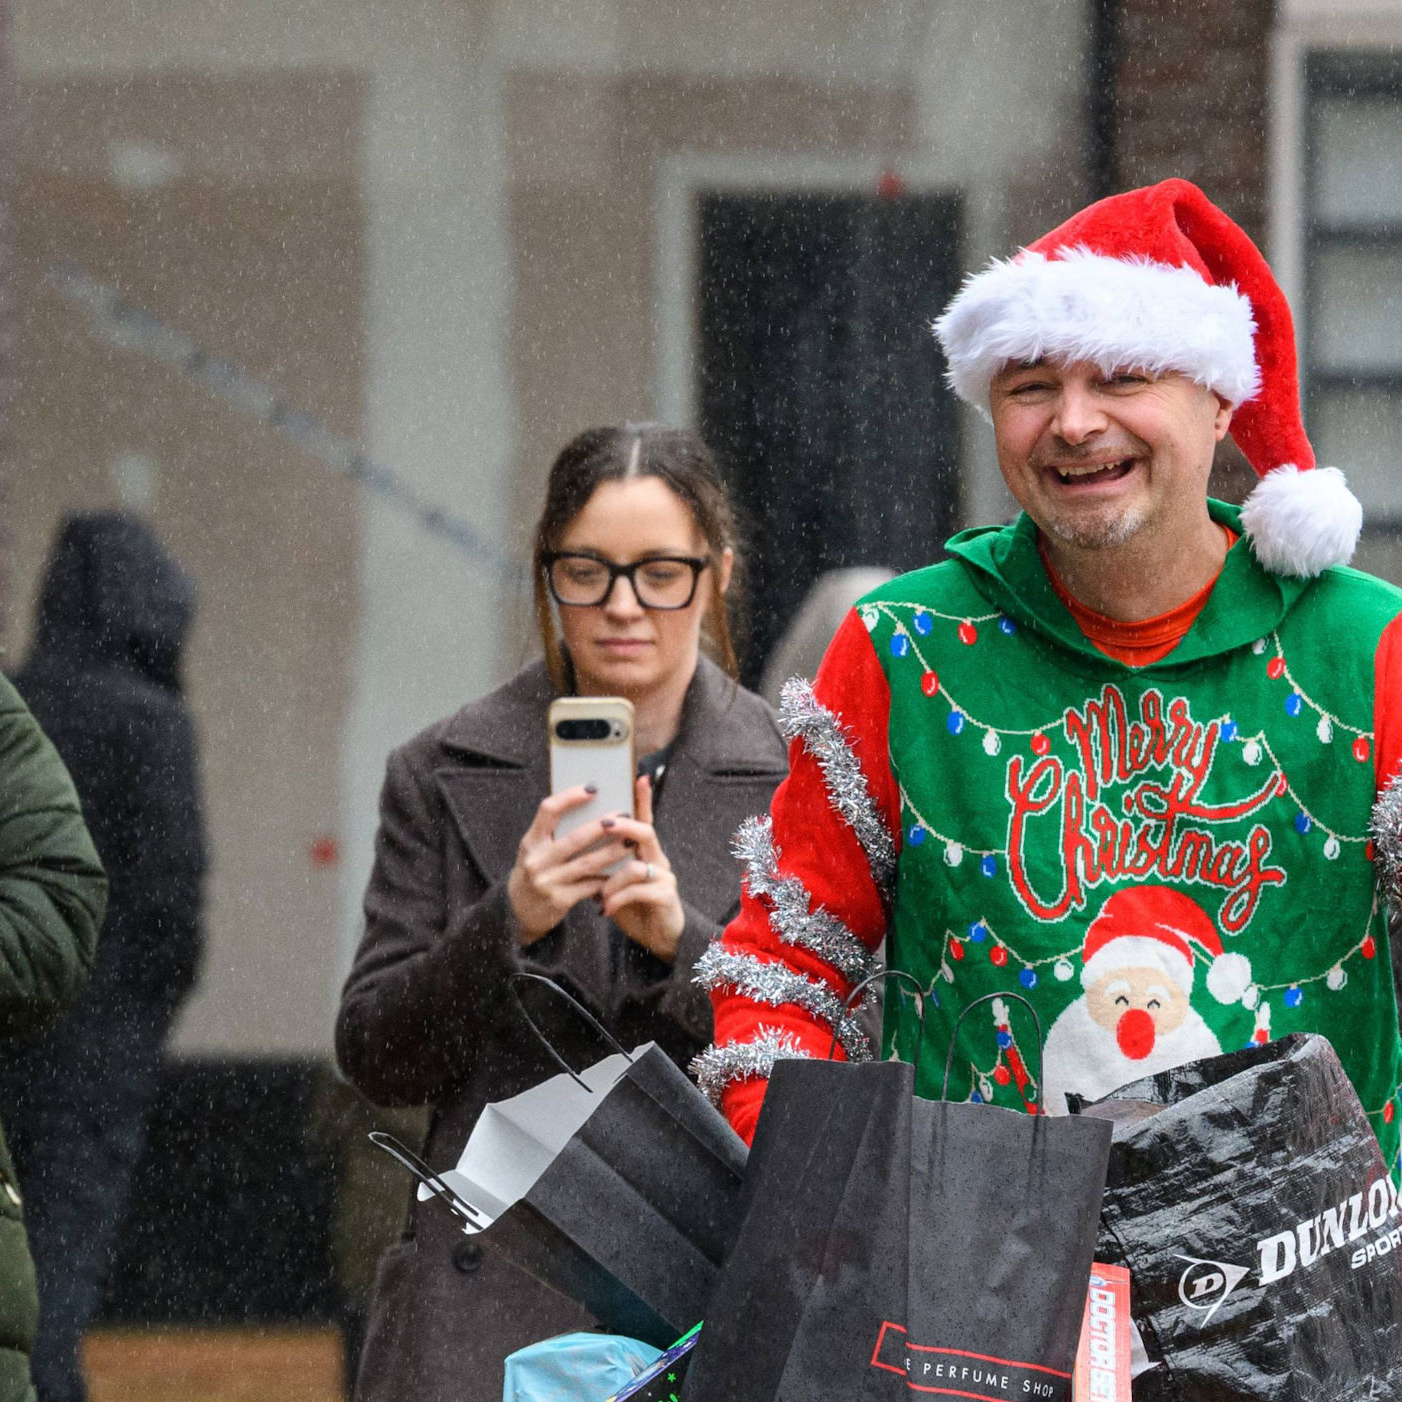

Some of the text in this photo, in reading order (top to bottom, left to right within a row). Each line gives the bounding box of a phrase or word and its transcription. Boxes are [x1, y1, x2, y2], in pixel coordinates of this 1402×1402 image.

[1063, 683, 1222, 804] Merry
[1004, 754, 1288, 935] Christmas
[1088, 1287, 1116, 1371] DOCTOR
[922, 1362, 1010, 1390] PERFUME
[1022, 1378, 1055, 1399] SHOP
